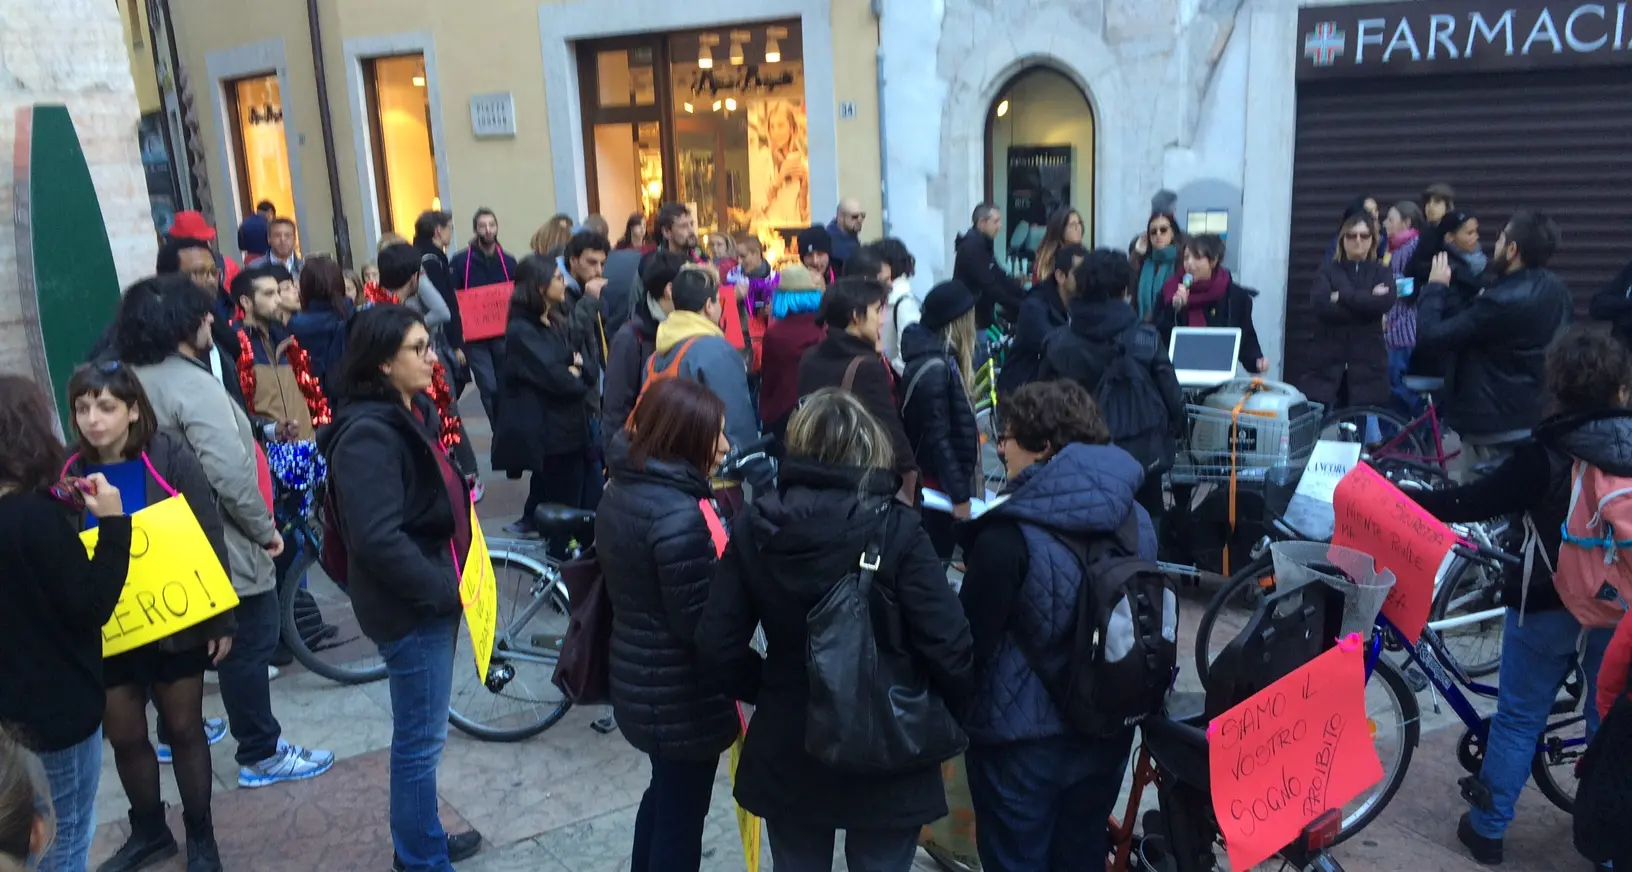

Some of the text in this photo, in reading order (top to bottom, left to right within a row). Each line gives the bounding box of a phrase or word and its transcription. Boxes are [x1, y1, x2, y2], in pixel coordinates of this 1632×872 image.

[1354, 2, 1632, 64] FARMACI
[1221, 672, 1317, 750] SIAMO IL
[1231, 718, 1307, 782] VOSTRO
[1302, 712, 1343, 817] PROIBITO
[1230, 765, 1301, 837] SOGNO
